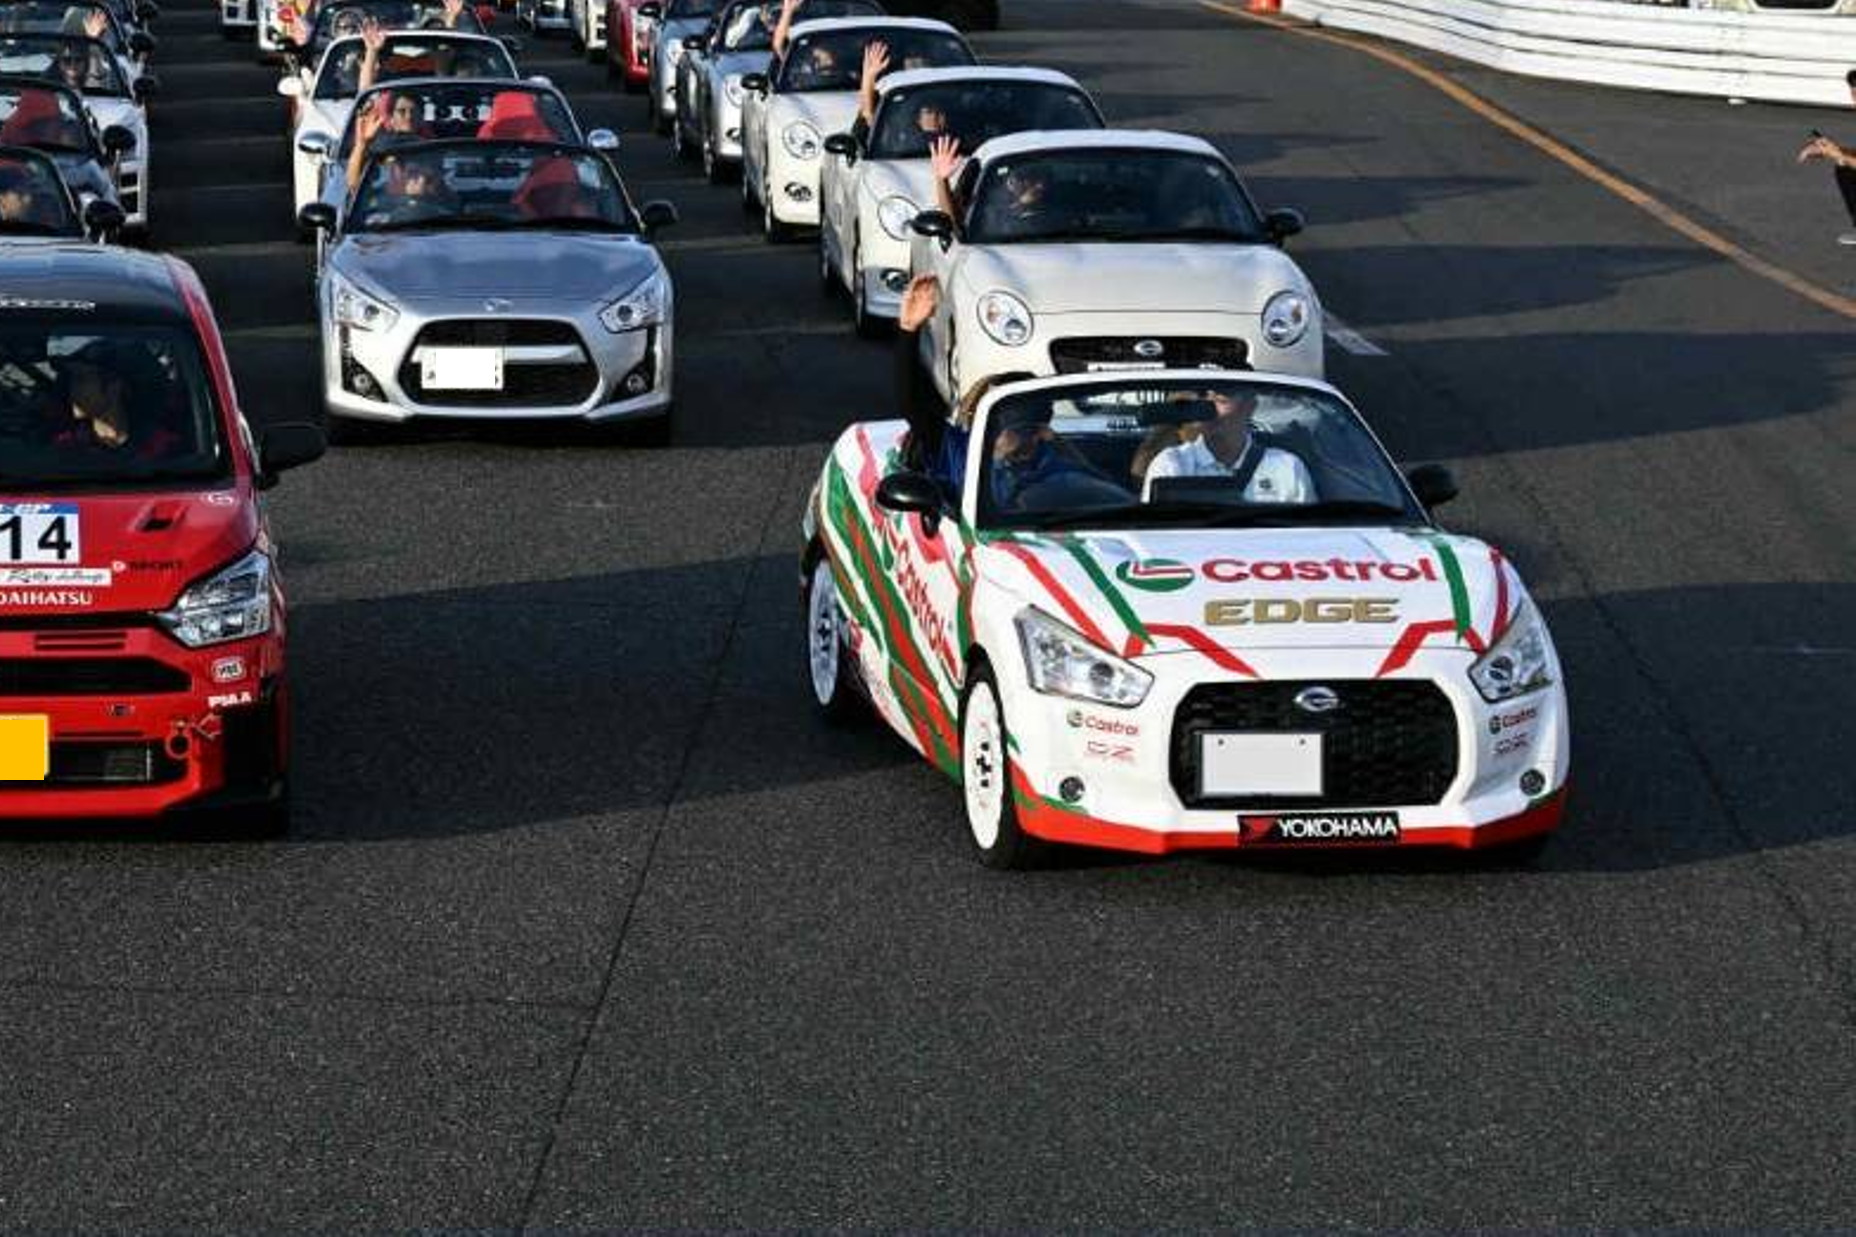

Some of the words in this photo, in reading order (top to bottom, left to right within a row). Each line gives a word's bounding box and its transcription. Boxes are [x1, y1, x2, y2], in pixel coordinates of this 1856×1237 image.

[1199, 557, 1438, 583] Castrol
[1204, 598, 1401, 626] EDGE
[207, 692, 252, 708] PIAA
[1279, 816, 1398, 839] YOKOHAMA
